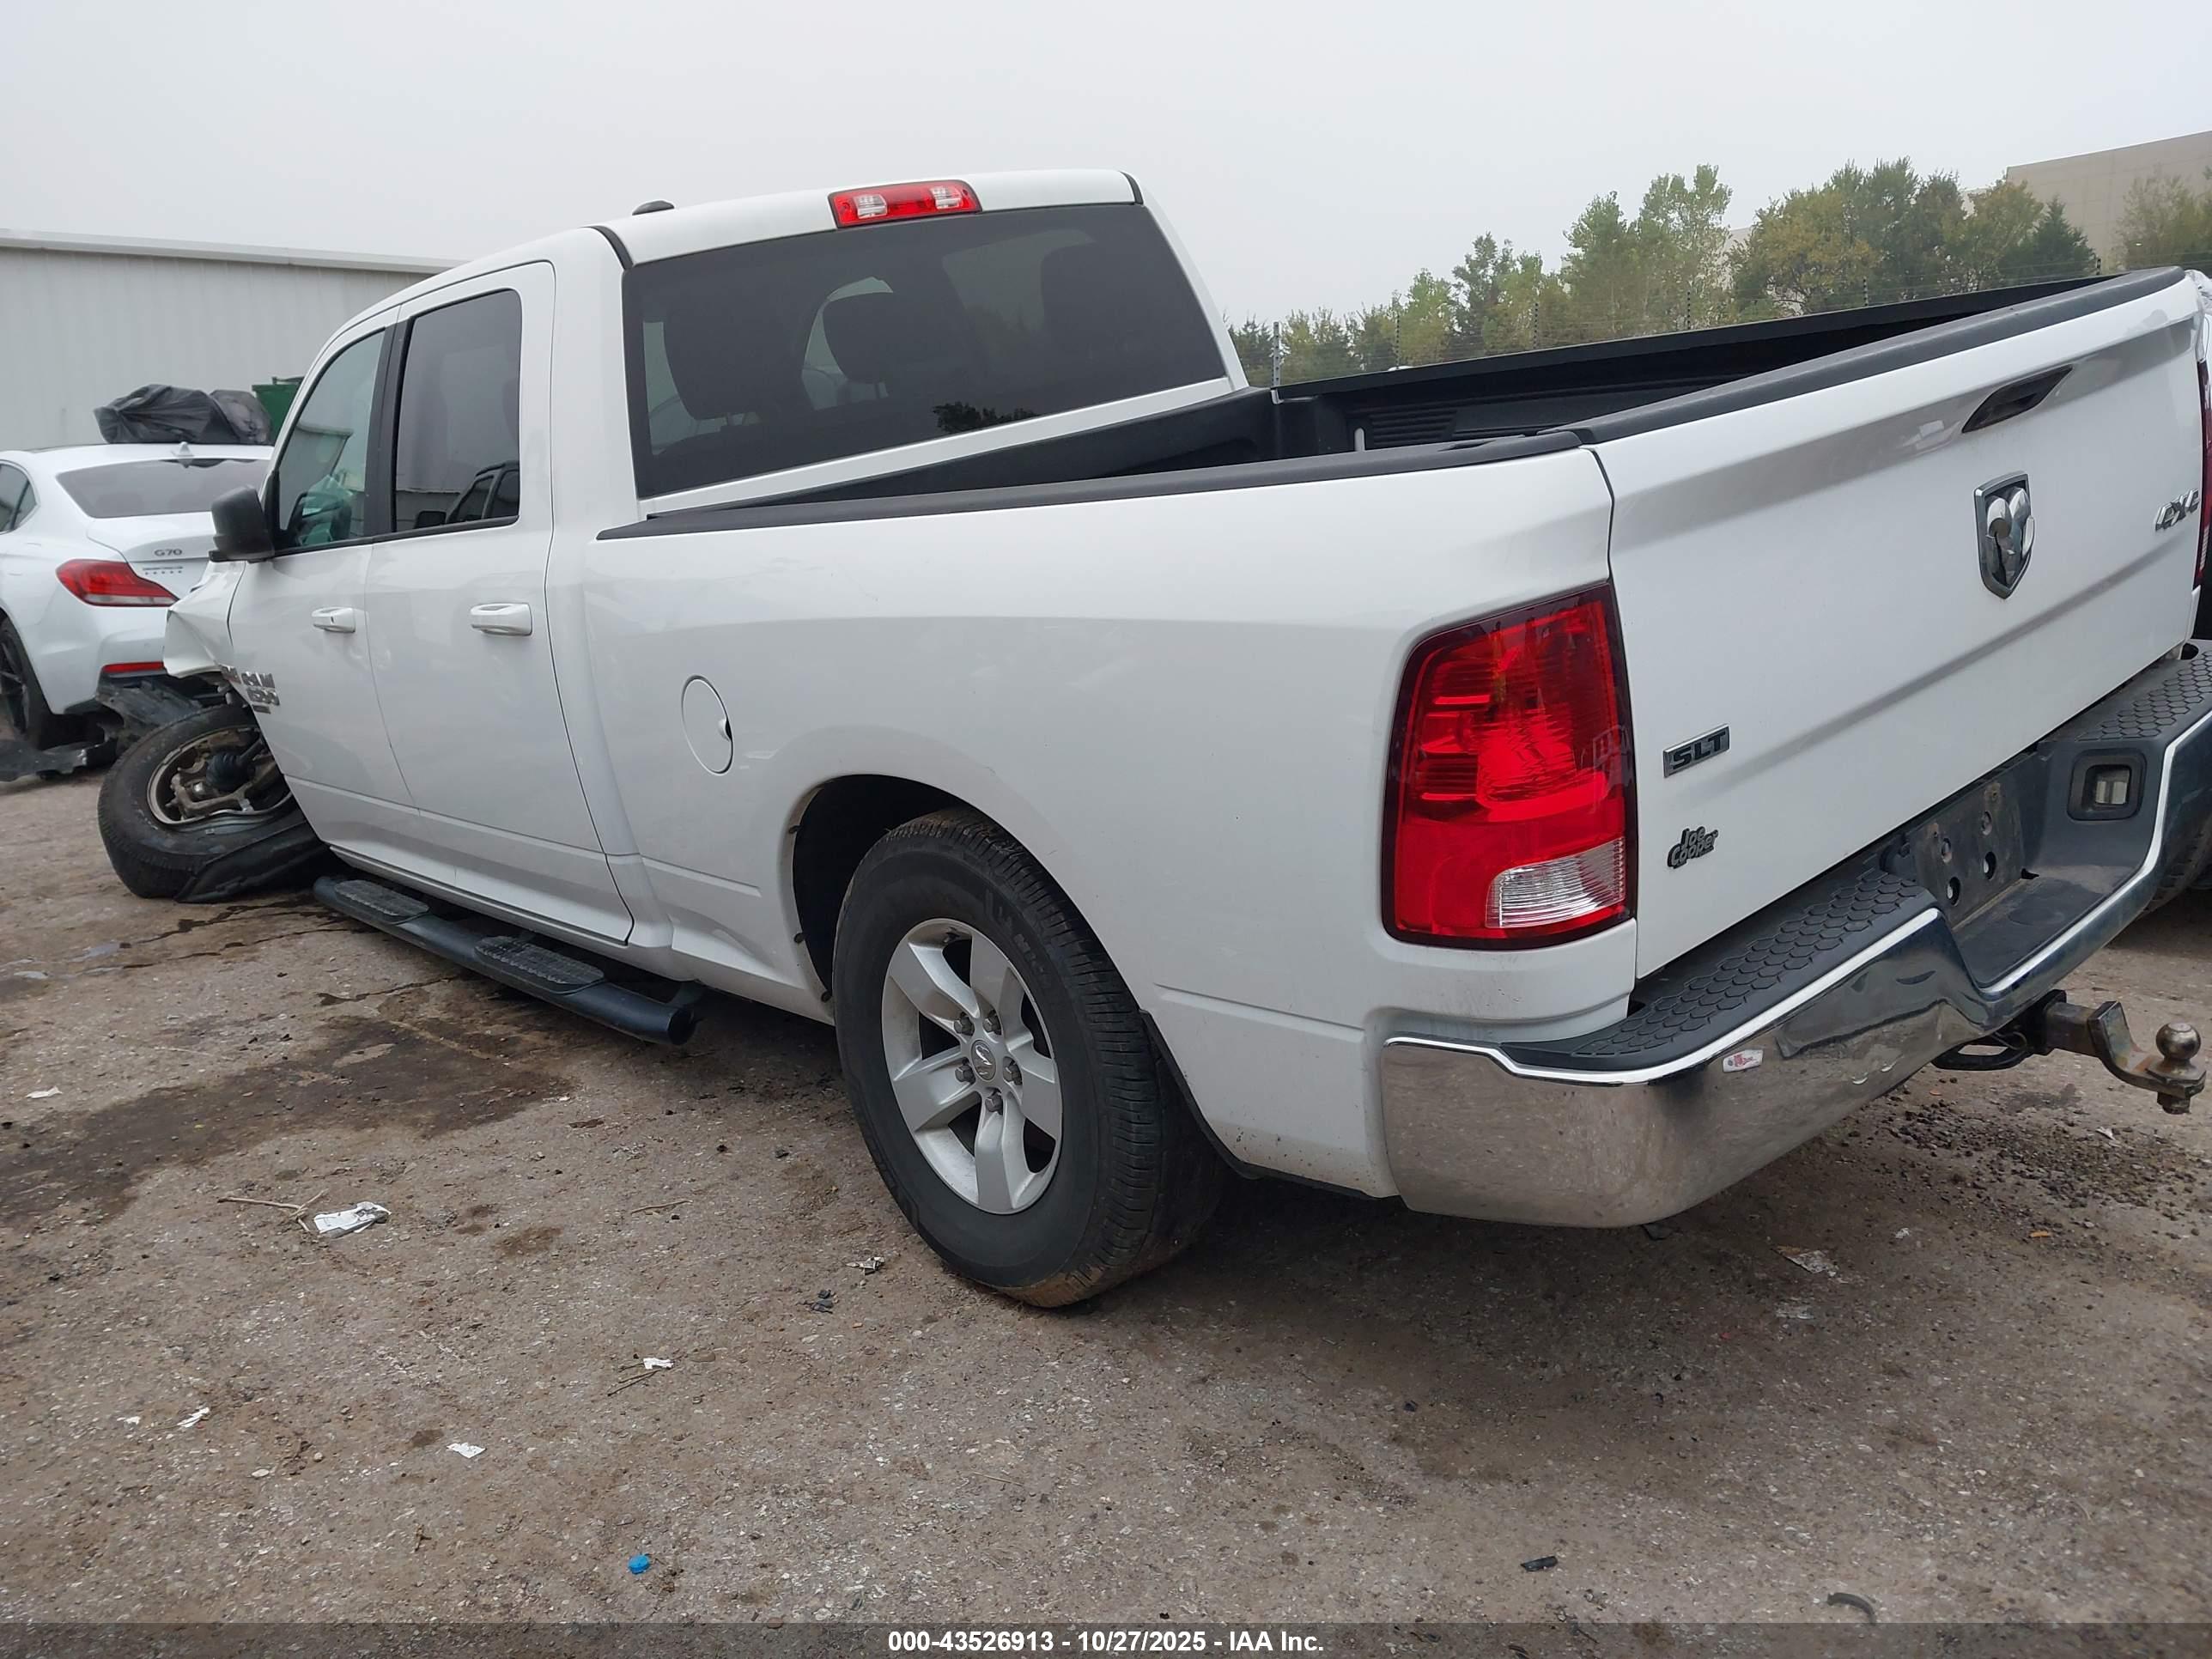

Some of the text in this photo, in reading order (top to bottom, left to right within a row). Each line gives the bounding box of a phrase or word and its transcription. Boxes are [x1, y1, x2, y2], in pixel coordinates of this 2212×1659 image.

[154, 548, 183, 557] G70
[1672, 731, 1726, 770] SLT
[1668, 830, 1718, 869] Cooper
[1680, 826, 1705, 849] Joe
